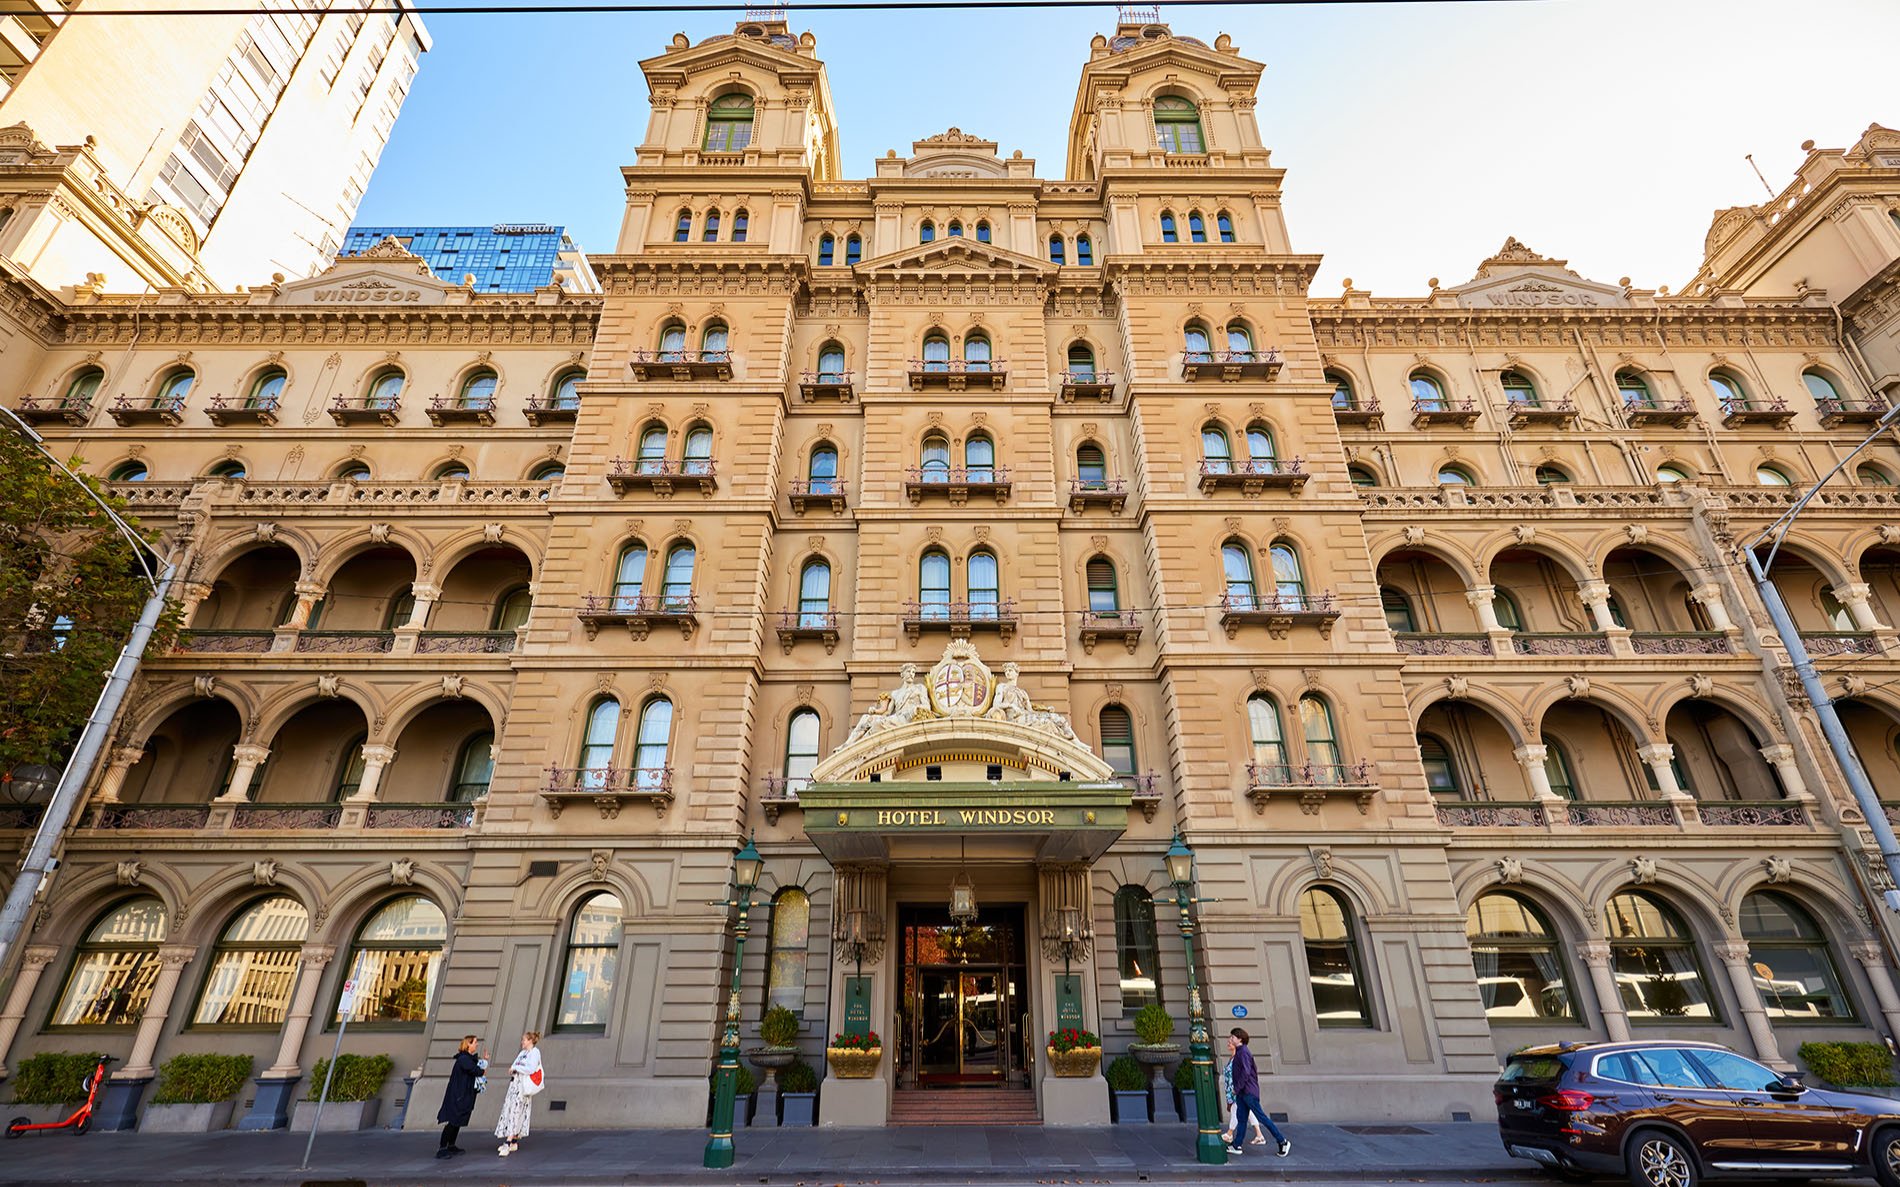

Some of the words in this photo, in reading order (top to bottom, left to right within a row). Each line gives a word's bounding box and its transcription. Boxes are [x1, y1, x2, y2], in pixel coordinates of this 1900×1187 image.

[492, 224, 555, 233] Sheraton
[313, 289, 421, 302] WINDSOR
[1486, 293, 1598, 307] WINDSOR
[877, 810, 946, 825] HOTEL
[958, 810, 1055, 825] WINDSOR
